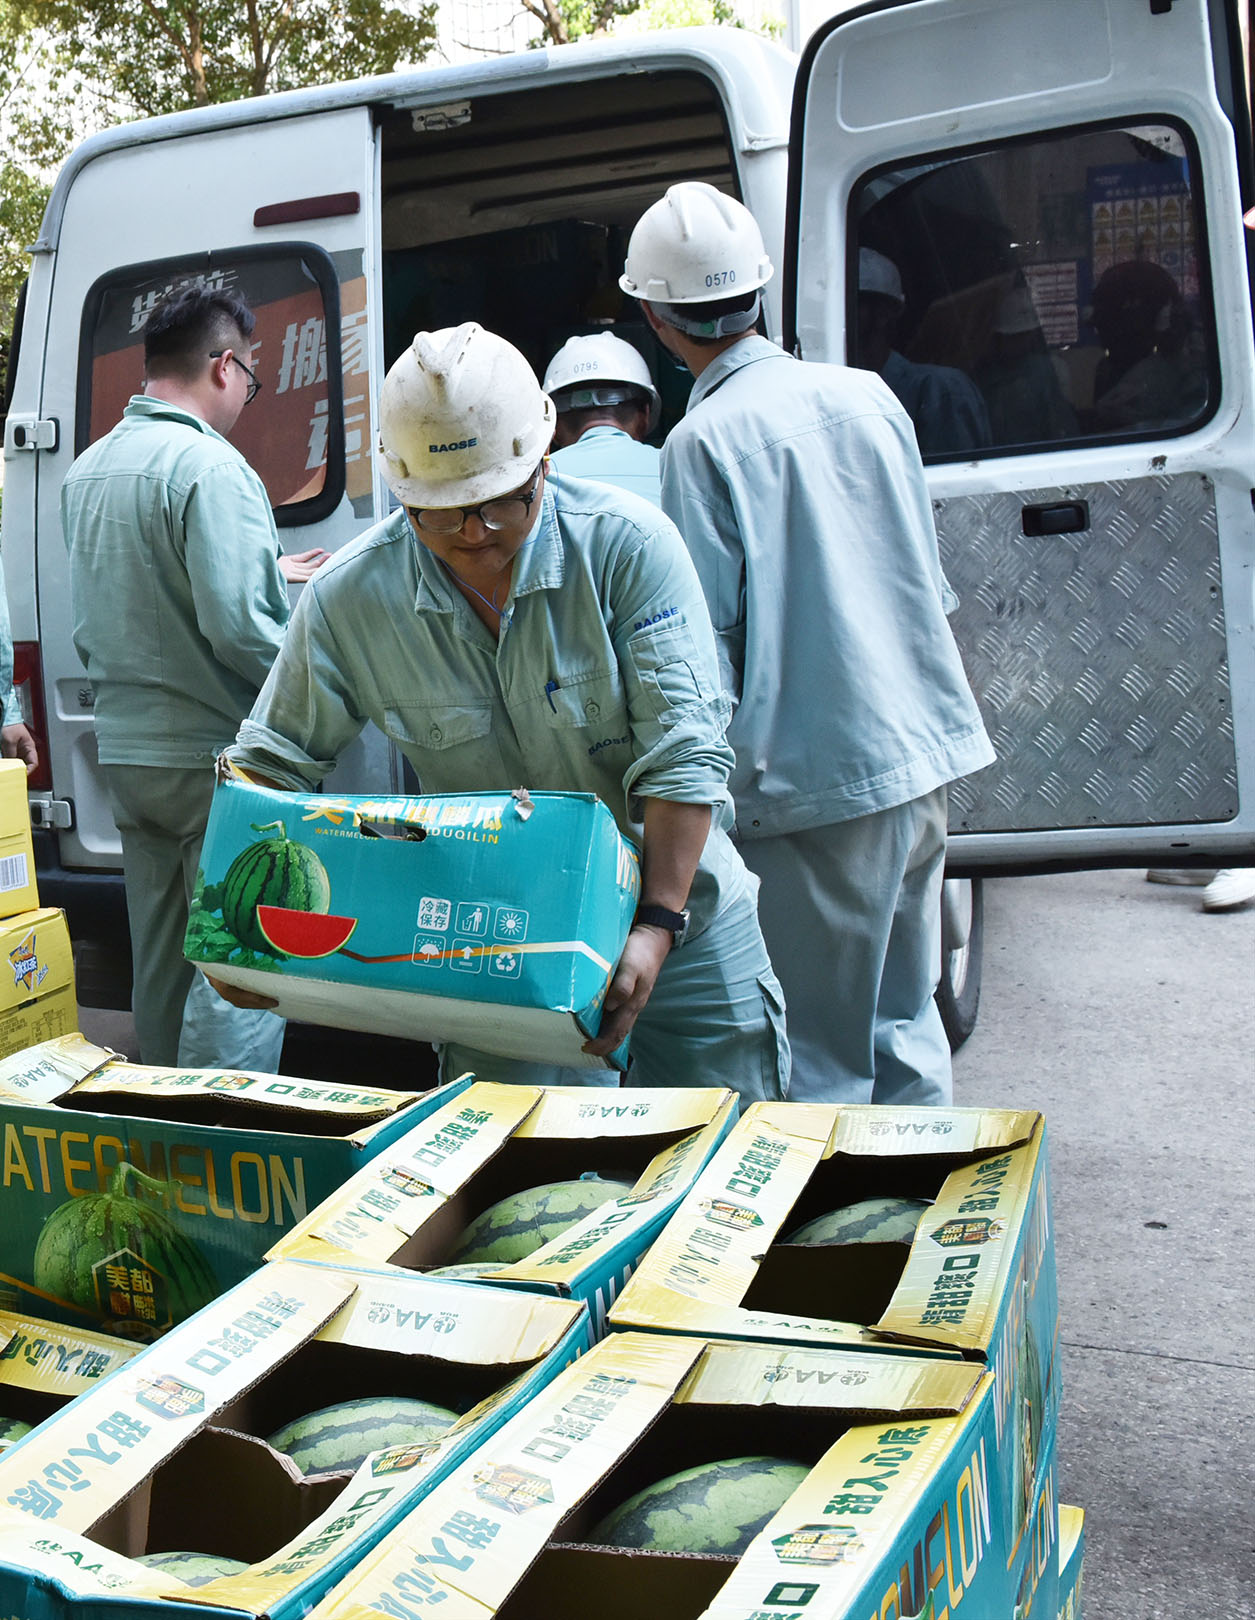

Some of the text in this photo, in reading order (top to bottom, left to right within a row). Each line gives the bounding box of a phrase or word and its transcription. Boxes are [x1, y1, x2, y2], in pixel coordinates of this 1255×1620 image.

[705, 271, 736, 288] 0570
[573, 361, 599, 374] 0795
[429, 437, 478, 454] BAOSE
[634, 606, 680, 632] BAOSE
[588, 735, 631, 756] BAOSE
[419, 898, 450, 915] 冷藏
[419, 913, 448, 929] 保存
[7, 1411, 153, 1520] 甜入心底
[823, 1425, 932, 1516] 甜入心底
